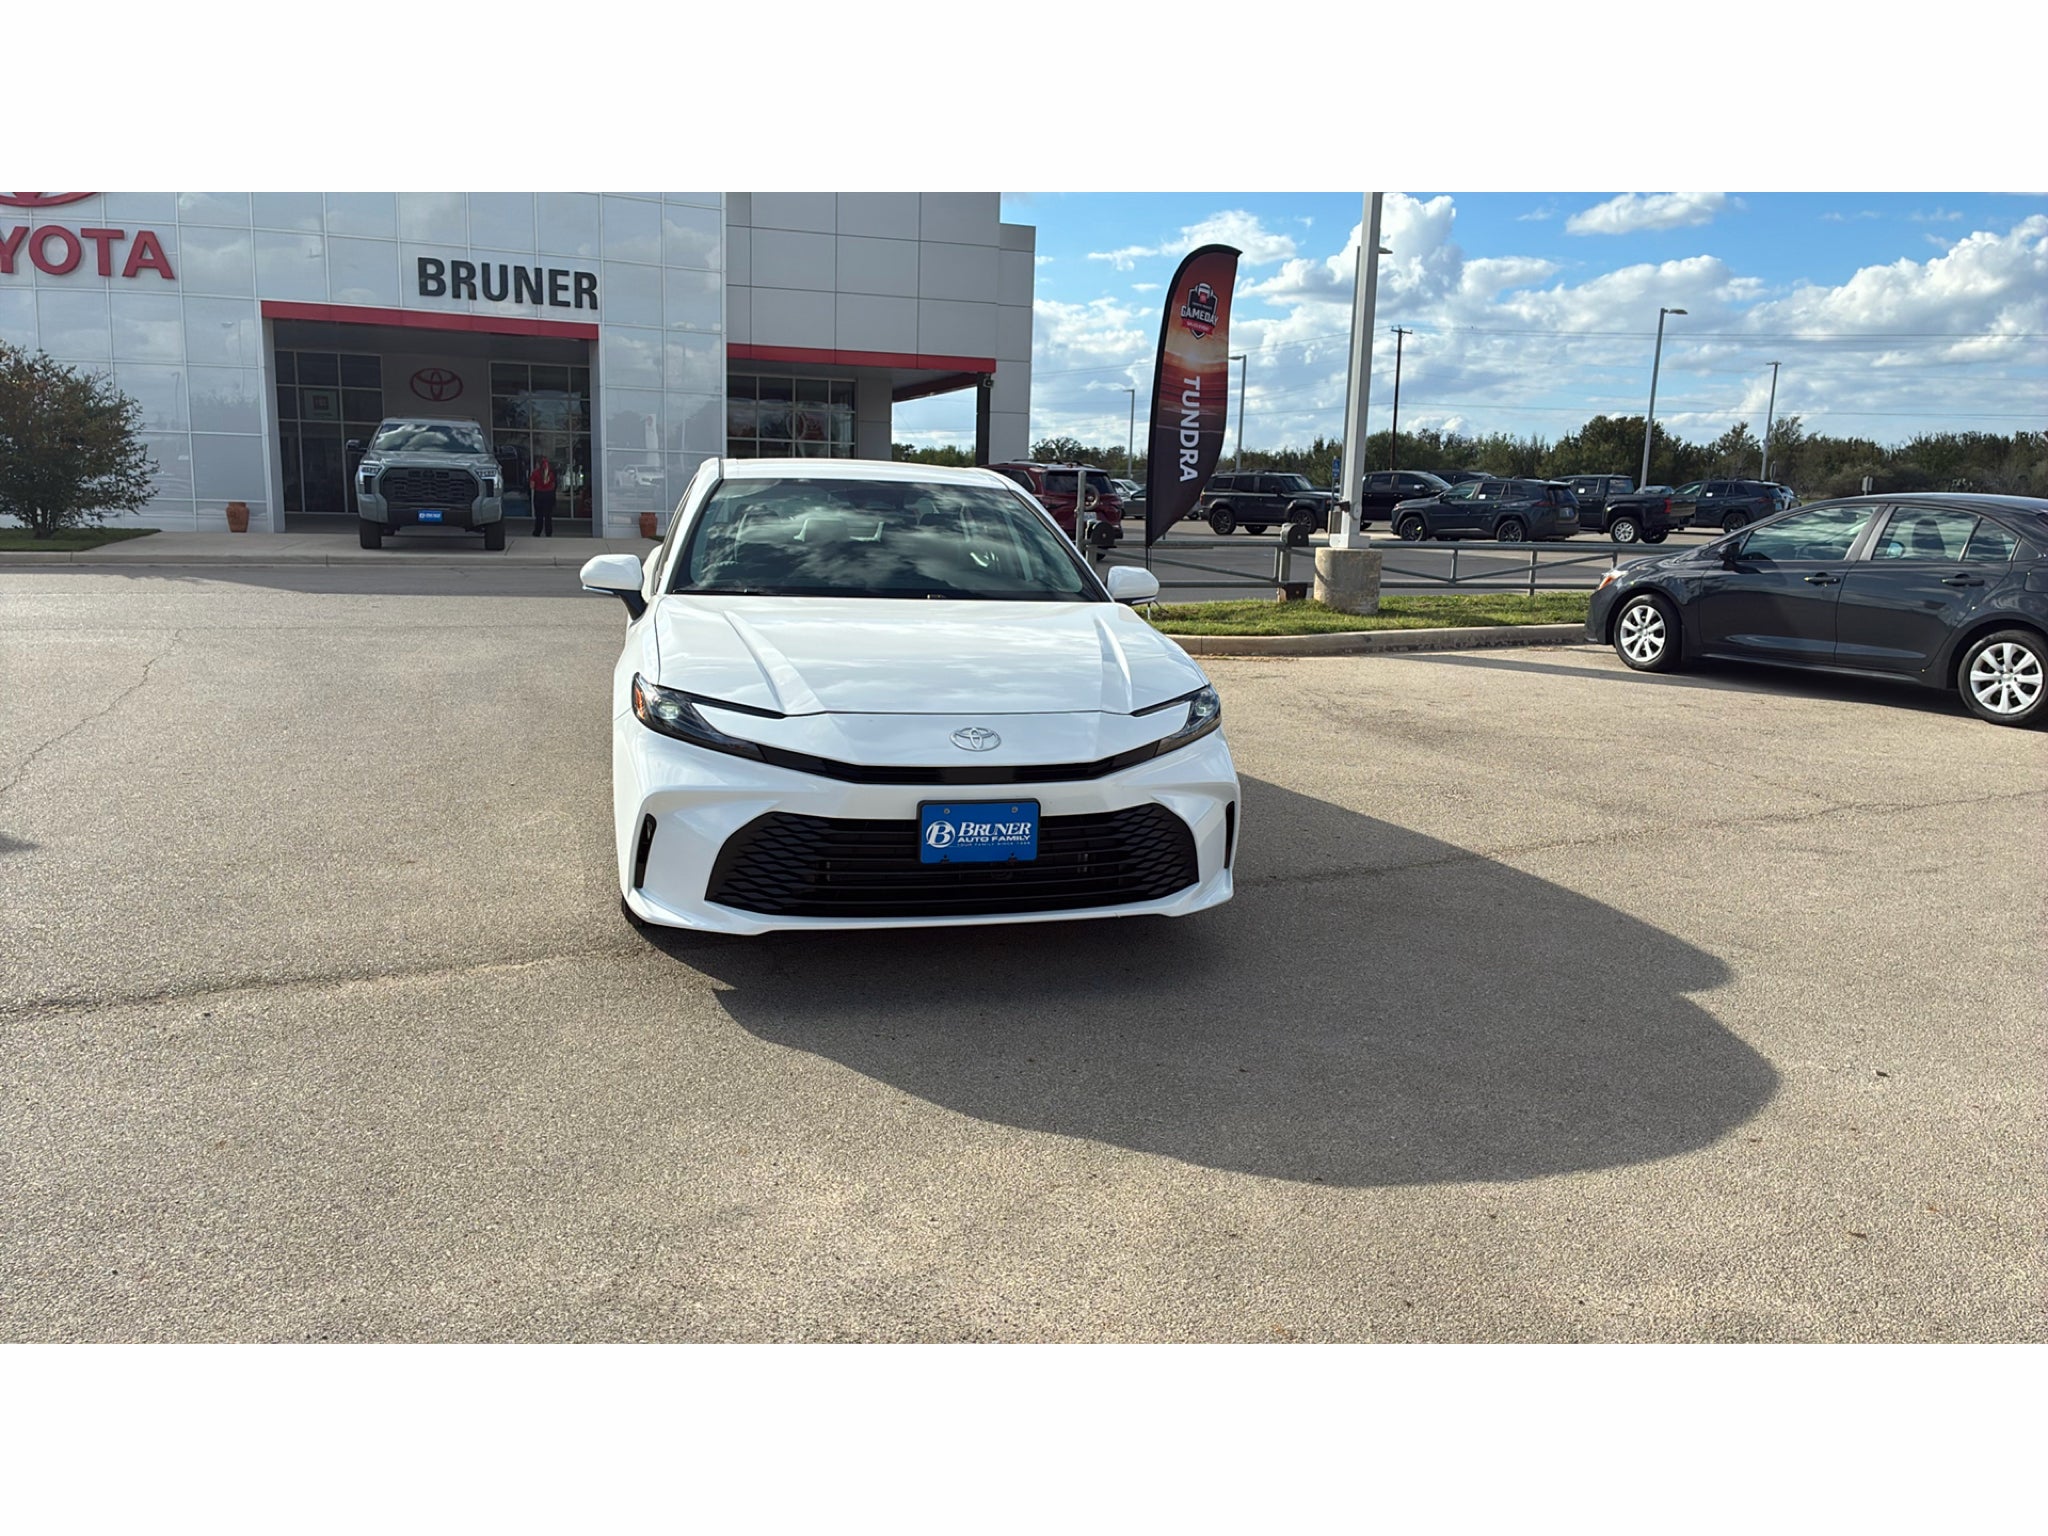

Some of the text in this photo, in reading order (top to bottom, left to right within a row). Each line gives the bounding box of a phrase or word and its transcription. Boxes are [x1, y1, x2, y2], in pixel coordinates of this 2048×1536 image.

[417, 256, 599, 310] BRUNER
[1181, 304, 1219, 327] GAMEDAY
[1179, 375, 1201, 482] TUNDRA
[958, 821, 1032, 837] BRUNER
